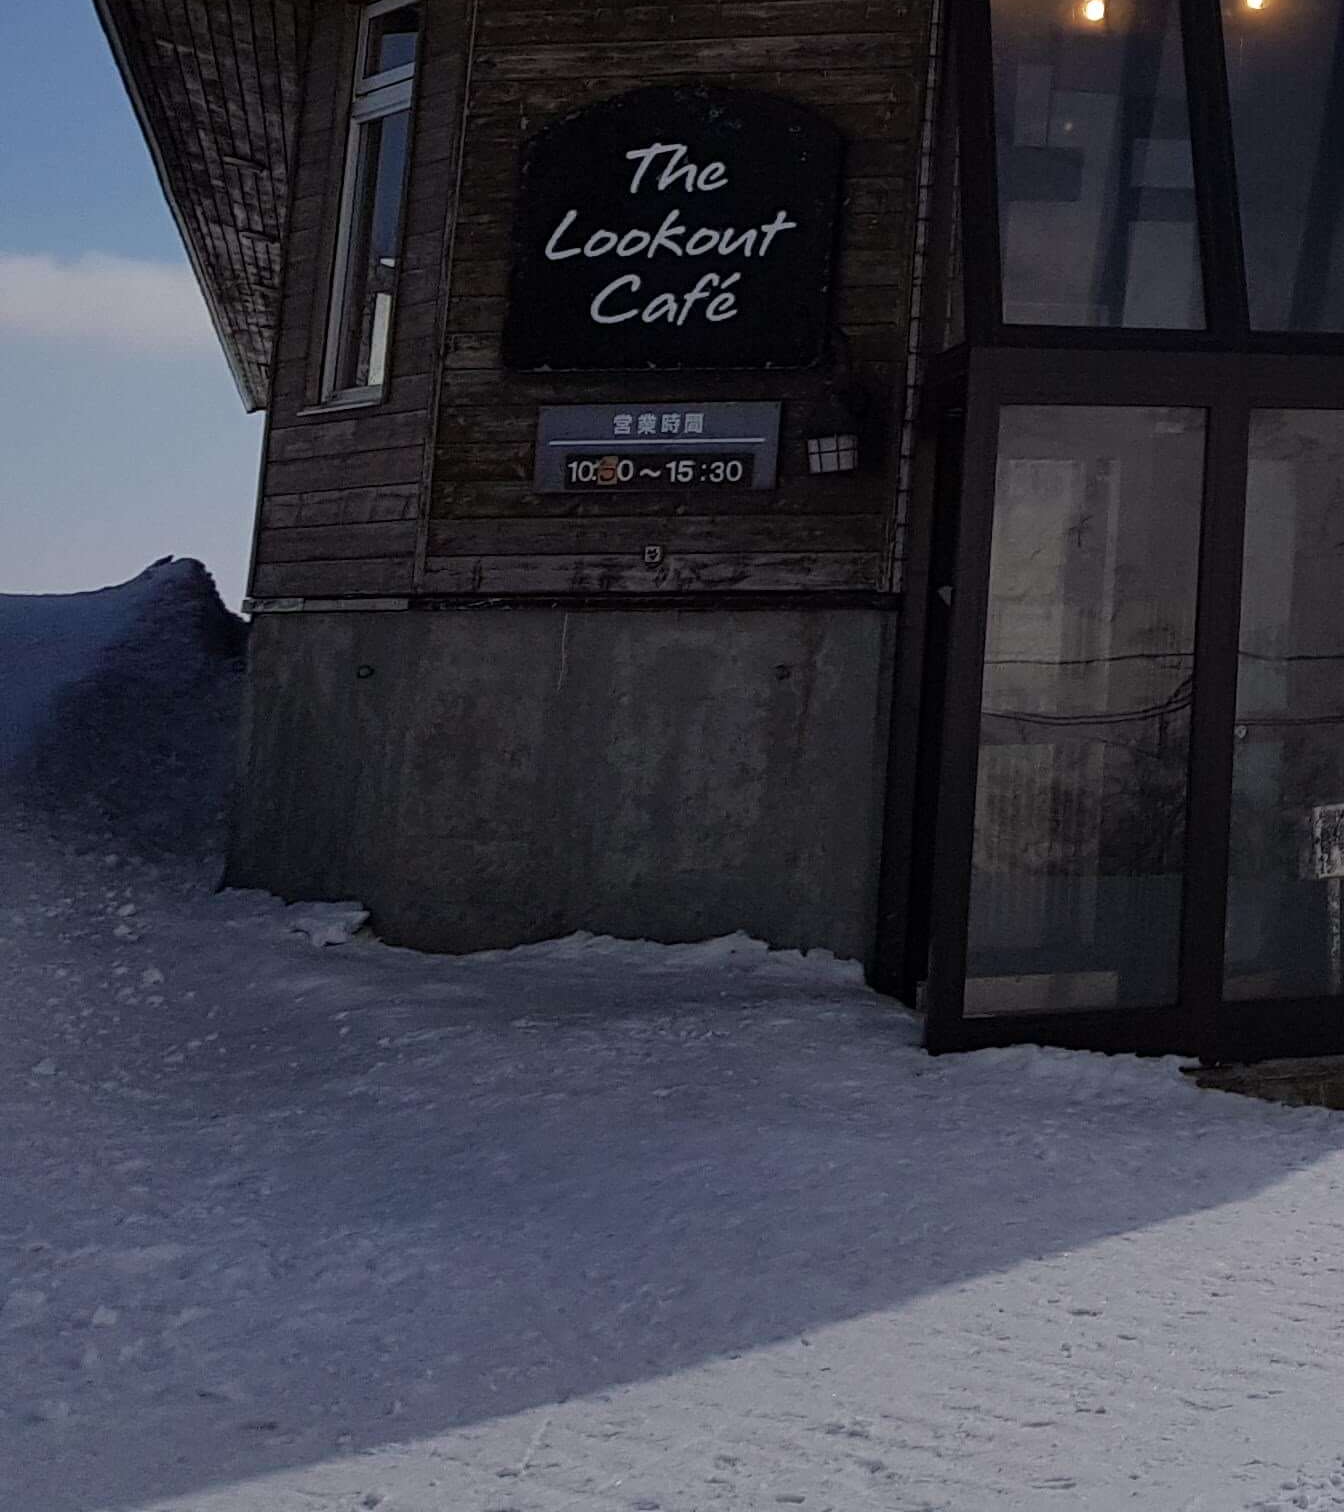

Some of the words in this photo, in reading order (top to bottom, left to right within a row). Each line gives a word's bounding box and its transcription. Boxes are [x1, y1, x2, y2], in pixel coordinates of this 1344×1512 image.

[626, 142, 729, 193] The
[545, 209, 797, 260] Lookout
[590, 272, 741, 326] Café
[613, 413, 704, 435] 営業時間
